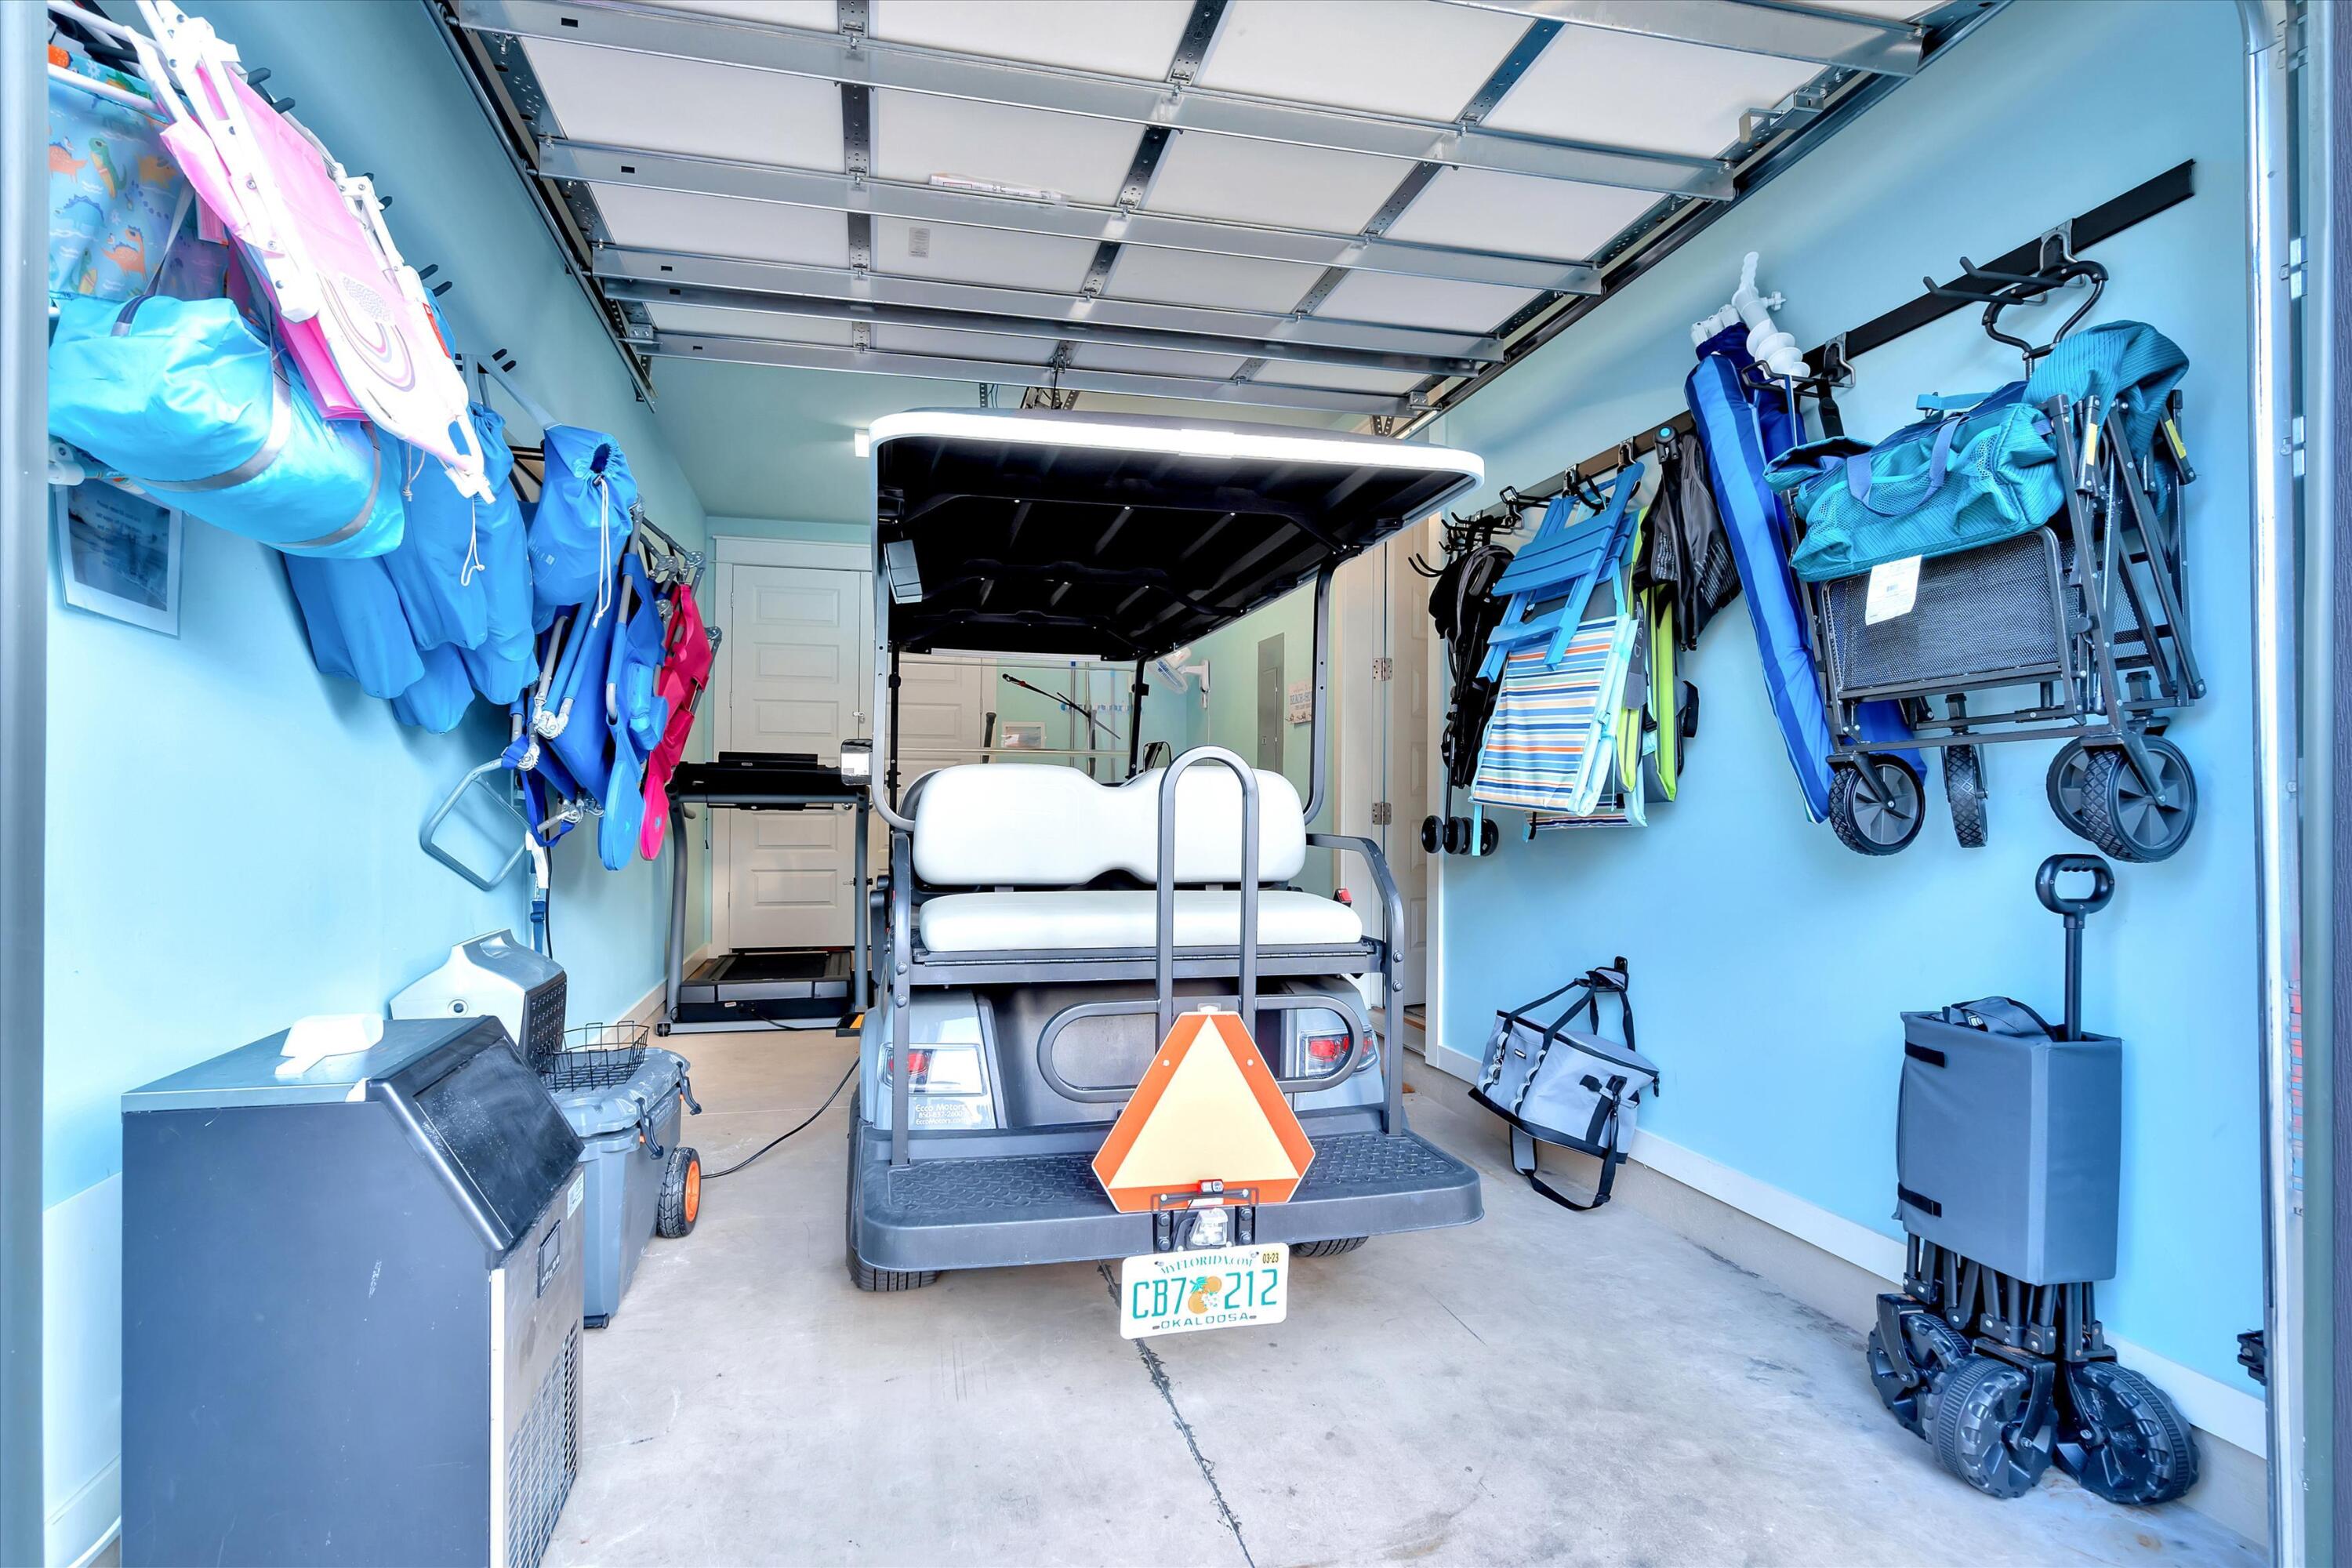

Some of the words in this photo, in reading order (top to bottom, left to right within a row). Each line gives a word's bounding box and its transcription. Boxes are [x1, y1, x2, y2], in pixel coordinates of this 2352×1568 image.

[1262, 1253, 1279, 1264] 03-23
[1132, 1276, 1187, 1319] CB7
[1224, 1269, 1278, 1309] 212
[1161, 1312, 1249, 1330] OKALOOSA
